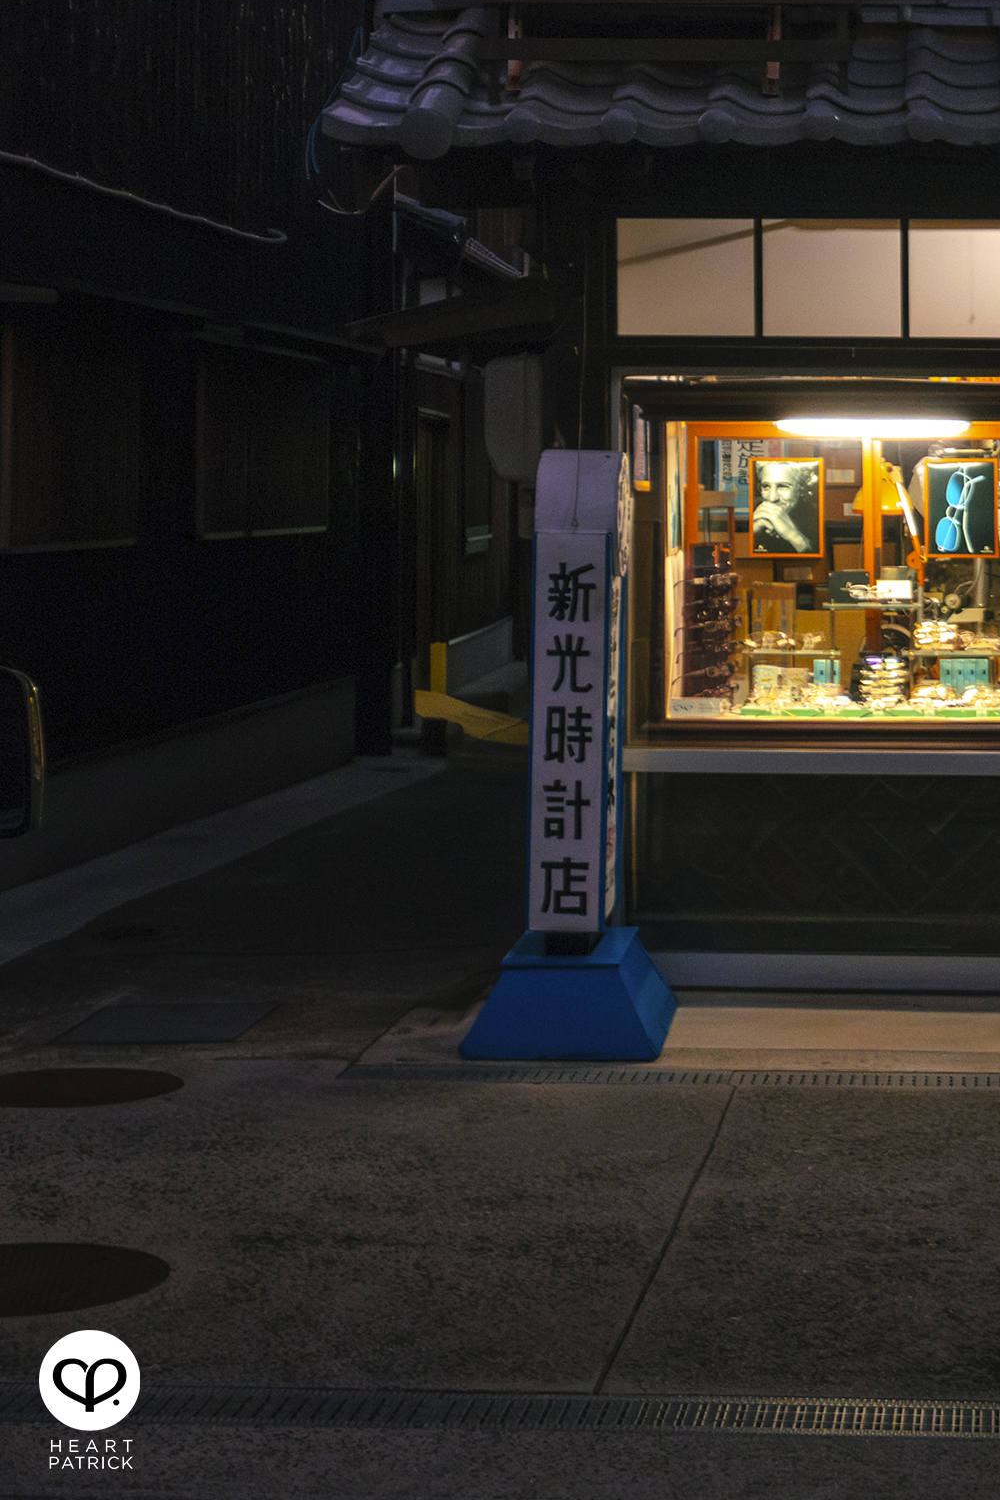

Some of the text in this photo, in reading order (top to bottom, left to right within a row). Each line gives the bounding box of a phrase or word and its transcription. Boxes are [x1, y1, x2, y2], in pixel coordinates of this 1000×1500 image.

[541, 562, 596, 916] 新光時計店
